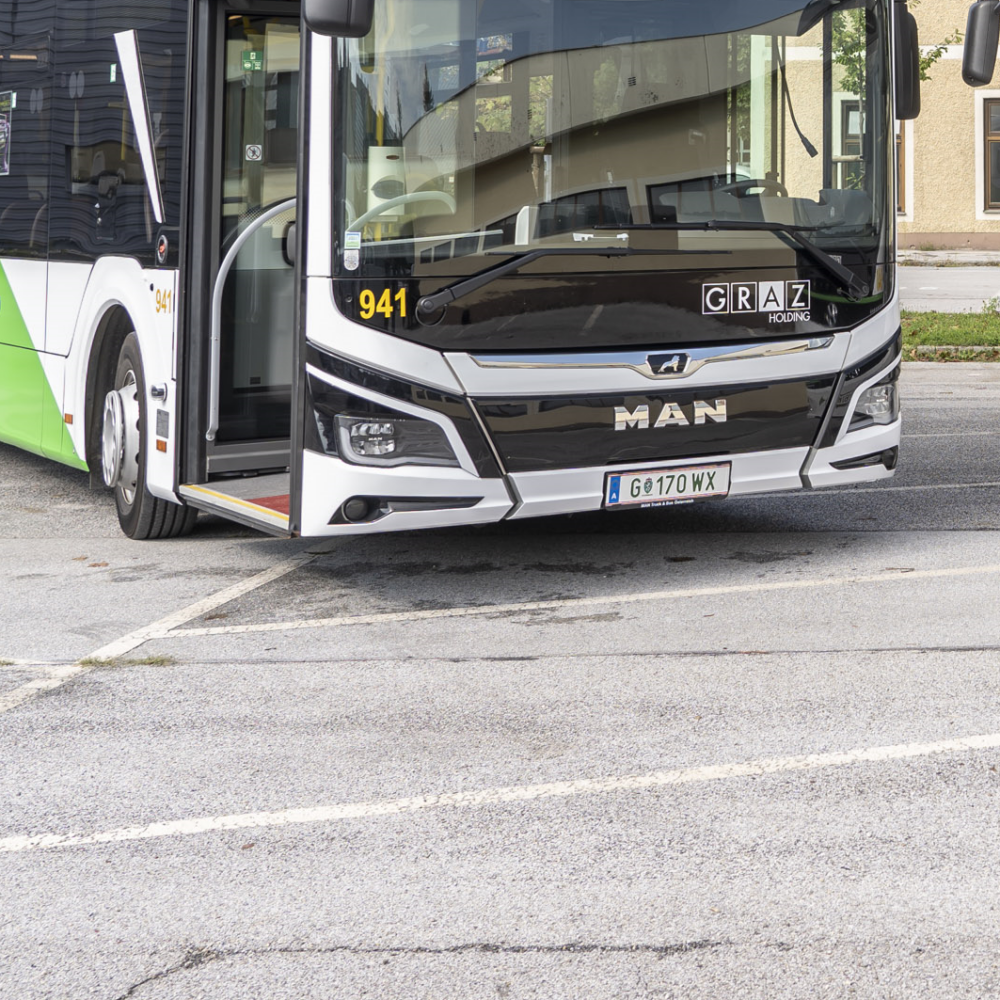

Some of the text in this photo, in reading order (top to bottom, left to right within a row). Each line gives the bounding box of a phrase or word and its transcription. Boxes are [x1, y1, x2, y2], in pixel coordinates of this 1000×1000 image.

[156, 288, 171, 314] 941
[359, 287, 406, 320] 941
[704, 281, 809, 313] GRAZ
[769, 311, 811, 323] HOLDING
[614, 399, 727, 431] MAN
